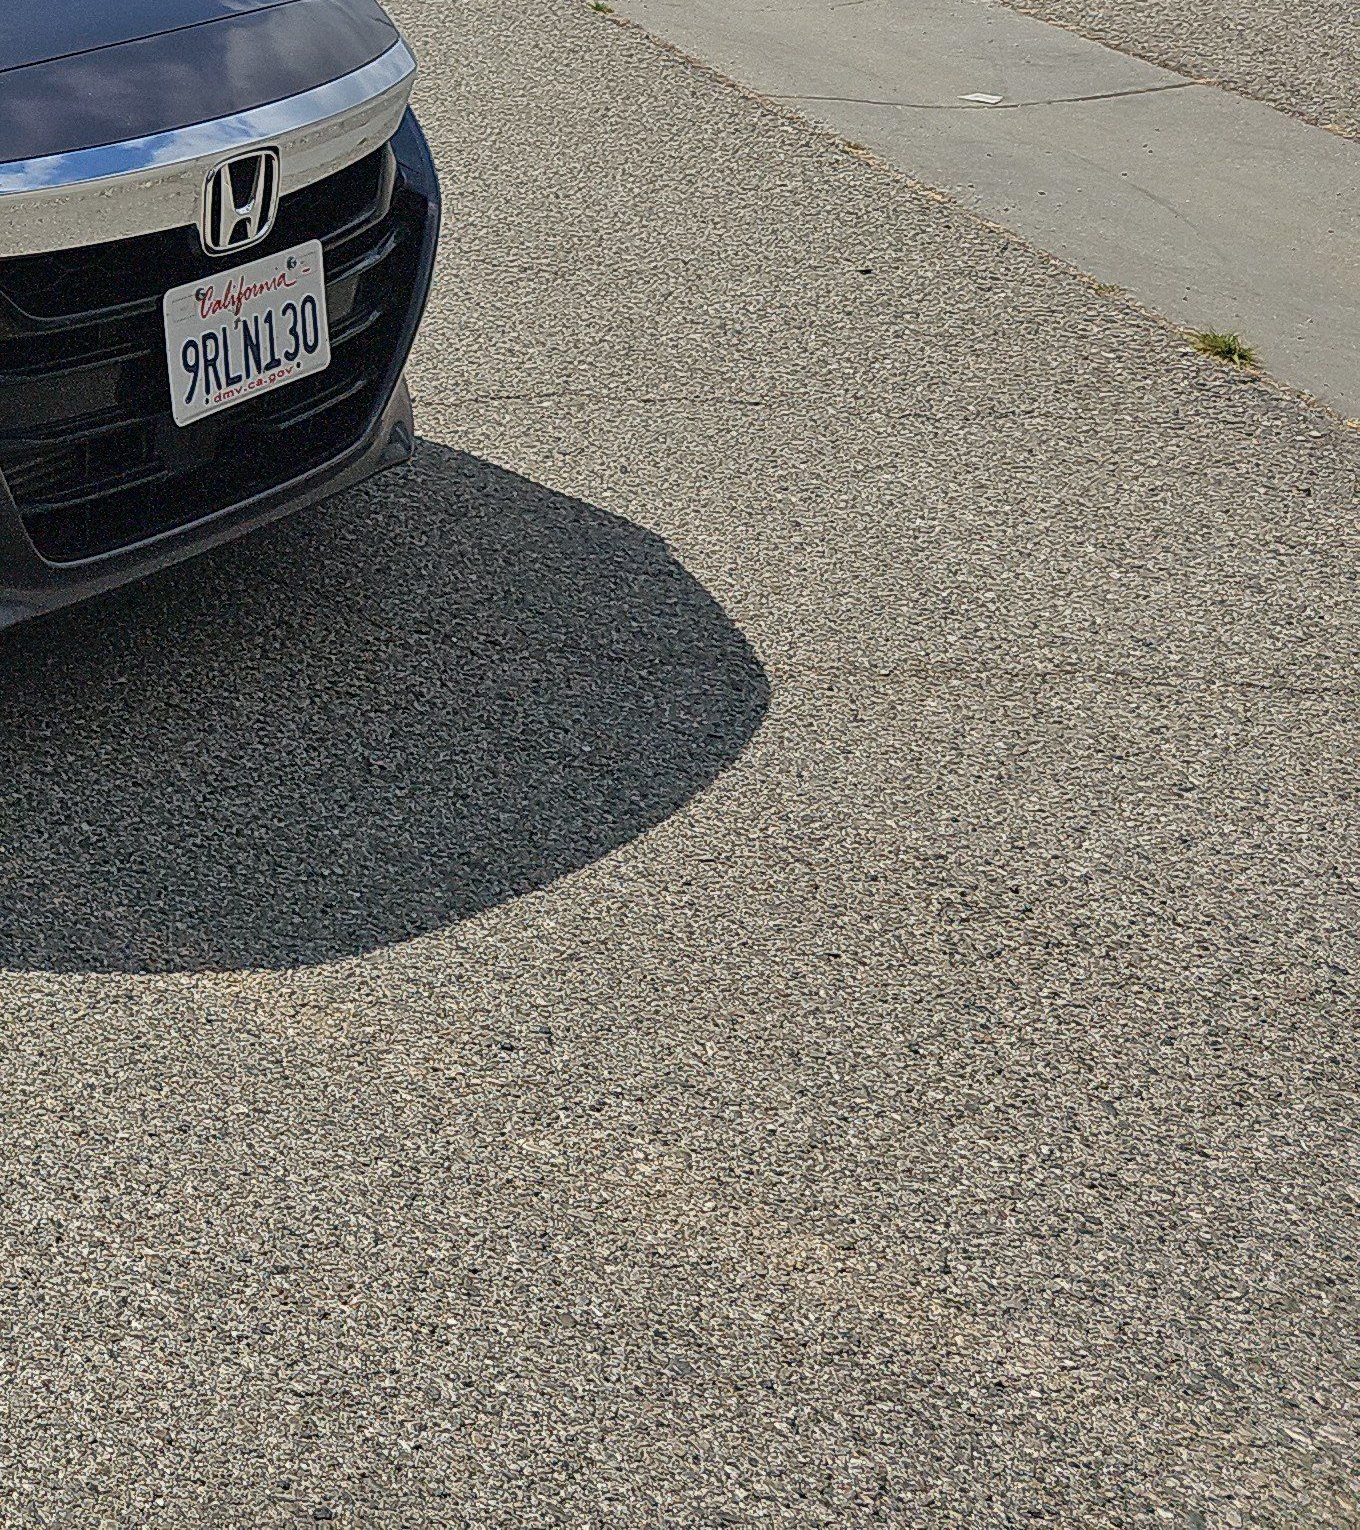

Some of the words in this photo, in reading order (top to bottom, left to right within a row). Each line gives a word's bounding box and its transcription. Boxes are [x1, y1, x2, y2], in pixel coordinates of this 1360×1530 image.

[199, 272, 297, 319] California
[182, 295, 319, 404] 9RLN130
[214, 366, 293, 403] dmv.ca.gov
